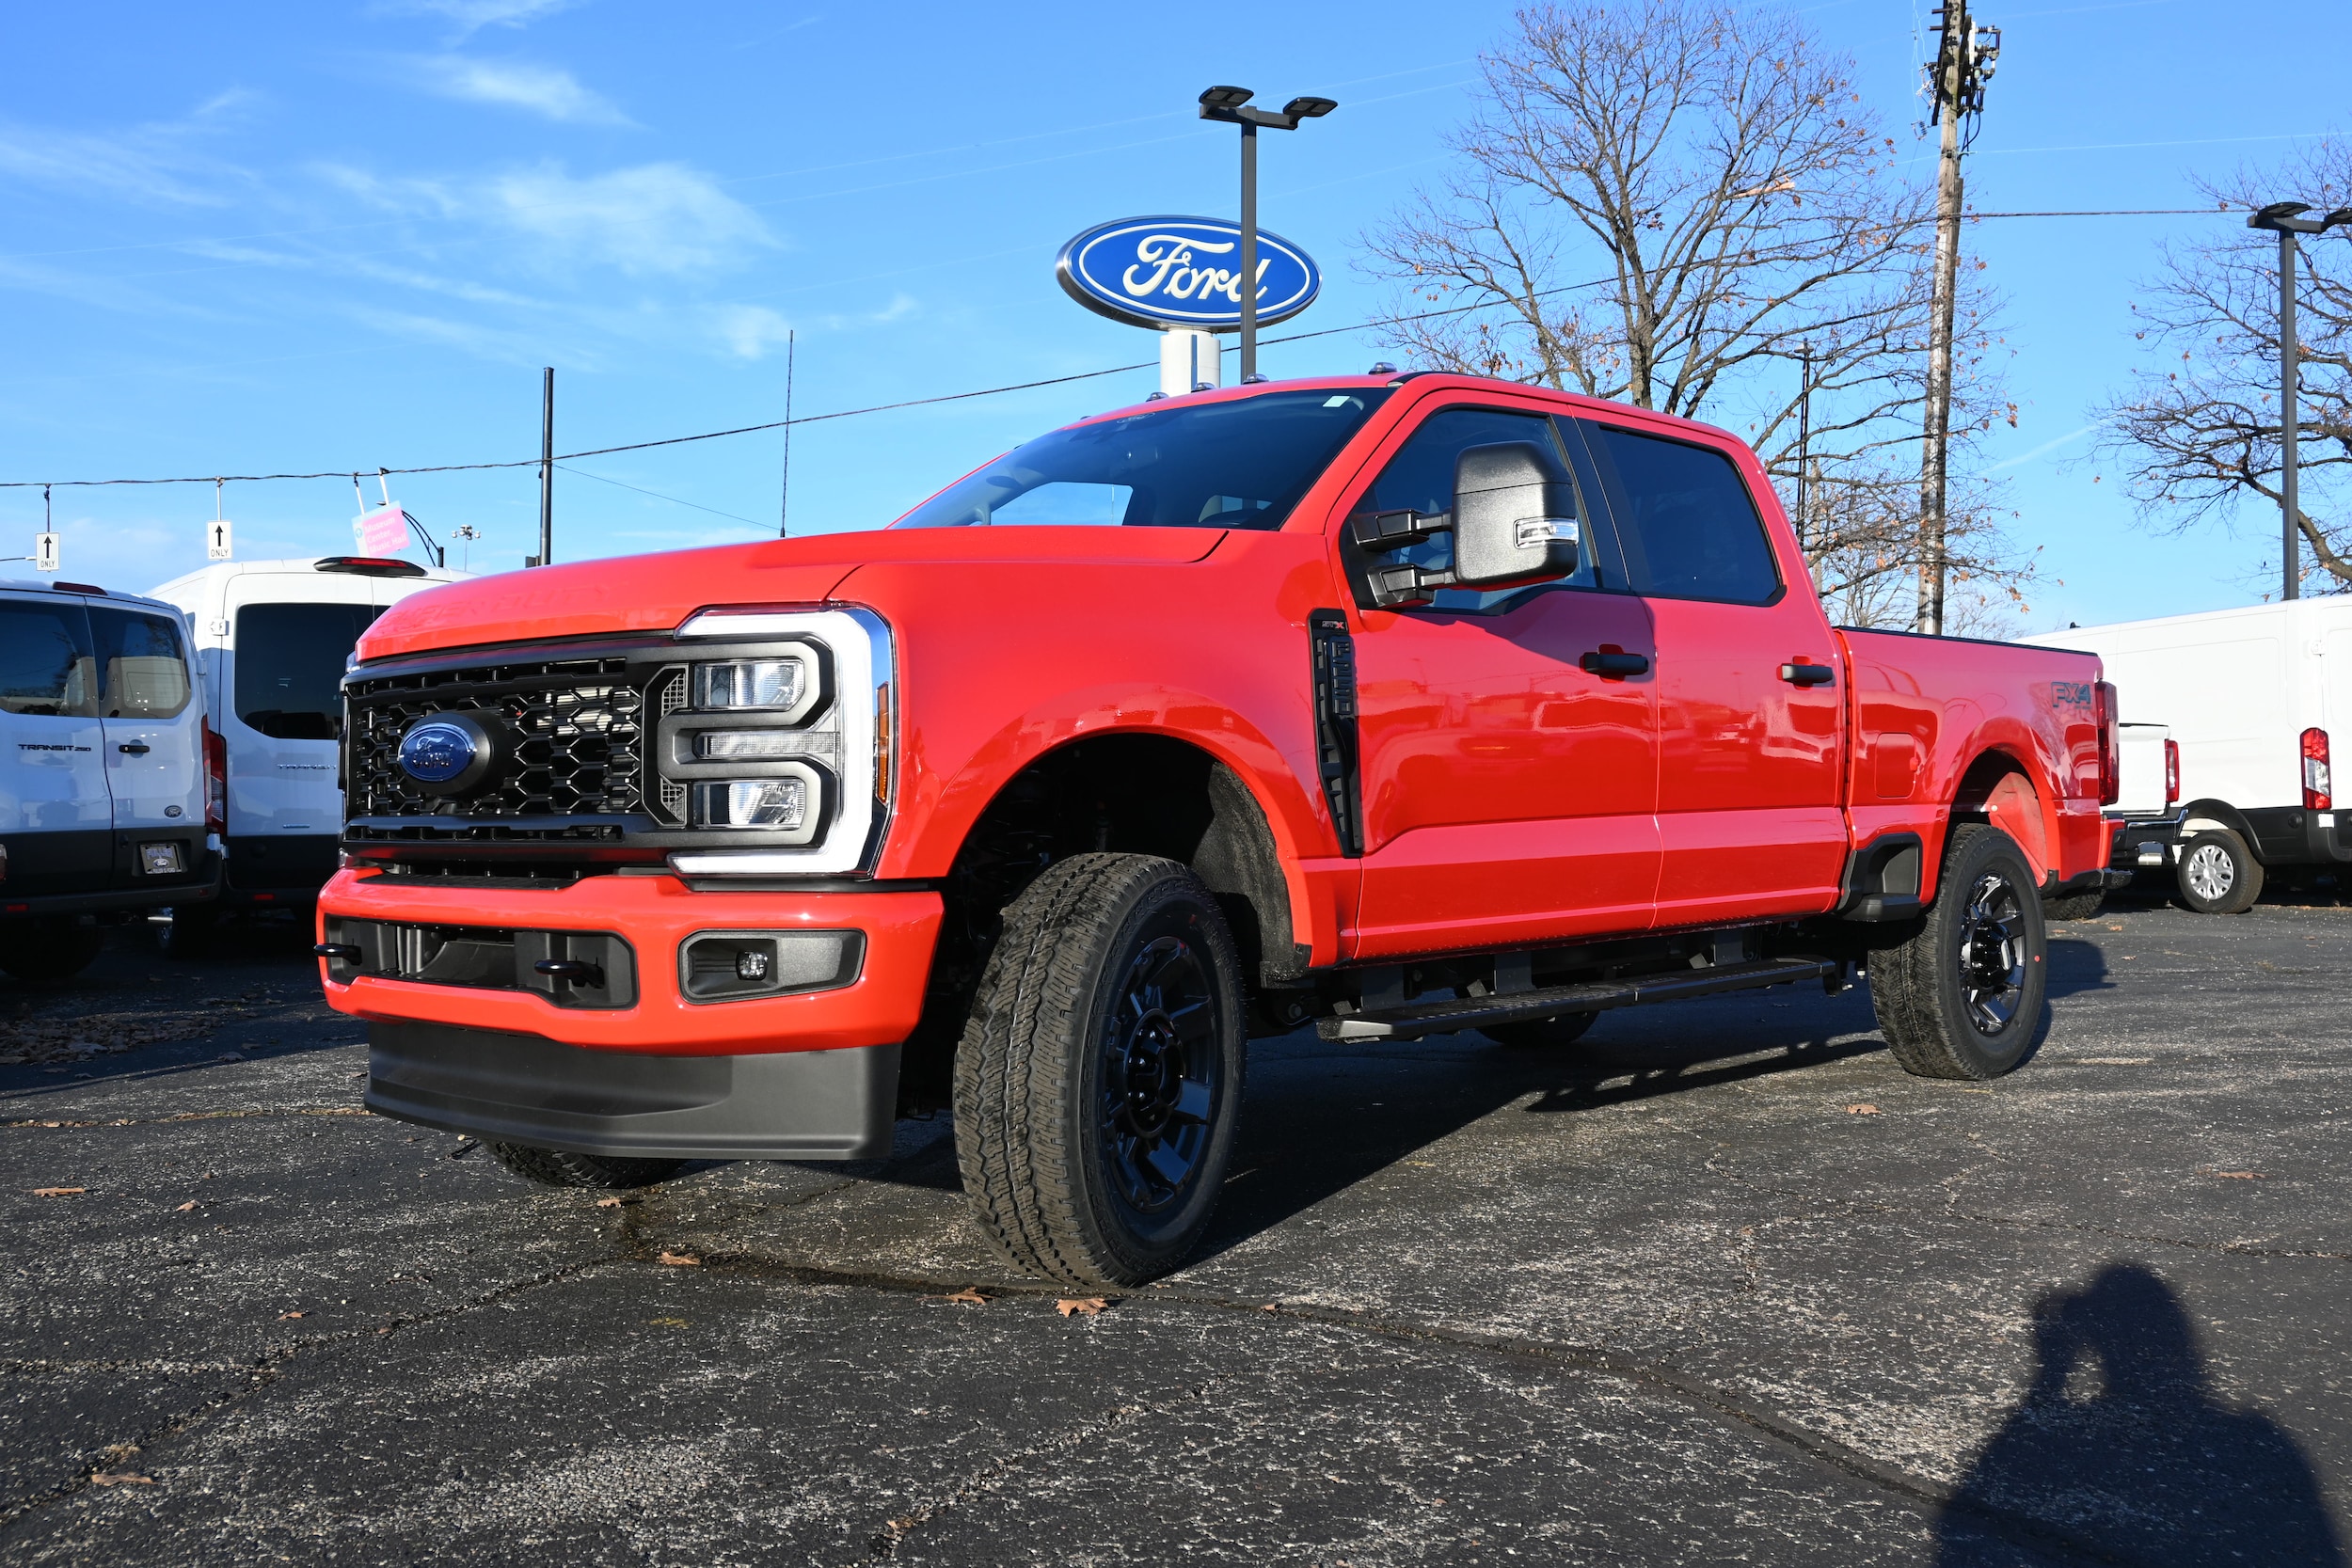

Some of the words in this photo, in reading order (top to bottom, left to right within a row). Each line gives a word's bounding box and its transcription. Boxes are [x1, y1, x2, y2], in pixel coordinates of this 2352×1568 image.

[1121, 234, 1272, 303] Ford
[364, 516, 396, 532] Museum
[369, 540, 391, 553] Music
[390, 533, 406, 546] Hall
[211, 548, 229, 557] ONLY
[40, 560, 56, 568] ONLY
[1321, 620, 1345, 629] STX
[2051, 681, 2091, 708] FX4
[17, 743, 74, 752] TRANSIT
